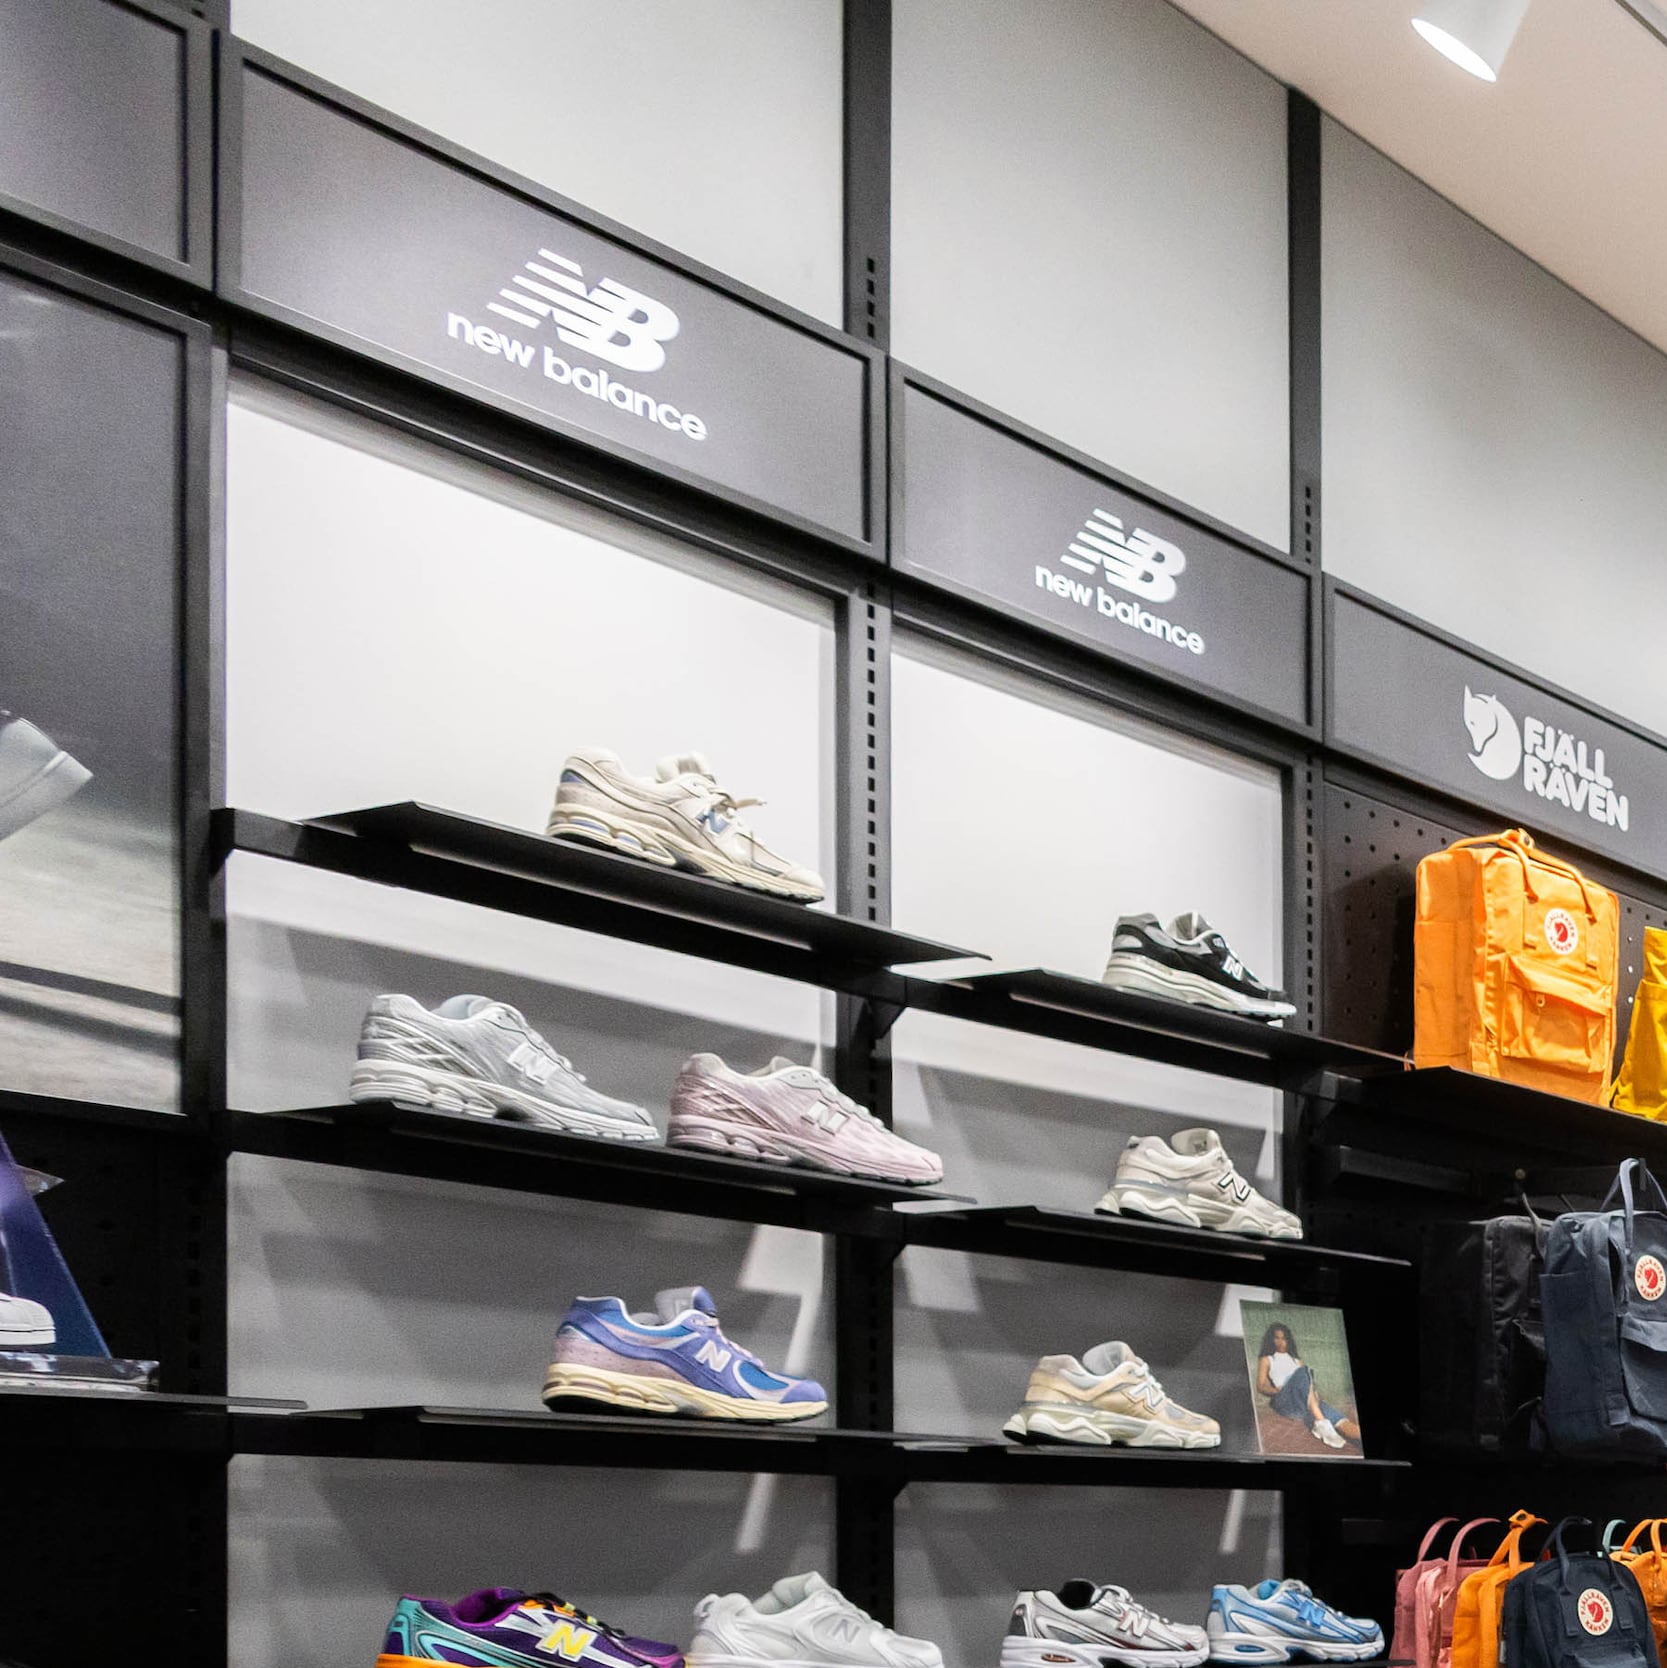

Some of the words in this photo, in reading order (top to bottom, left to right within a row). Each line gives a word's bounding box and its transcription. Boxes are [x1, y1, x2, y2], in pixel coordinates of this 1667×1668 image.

[447, 312, 536, 370] new
[543, 348, 708, 442] balance
[1035, 563, 1093, 608] new
[1097, 586, 1205, 655] balance
[1523, 716, 1614, 789] FJÄLL
[1524, 760, 1629, 832] RÄVEN
